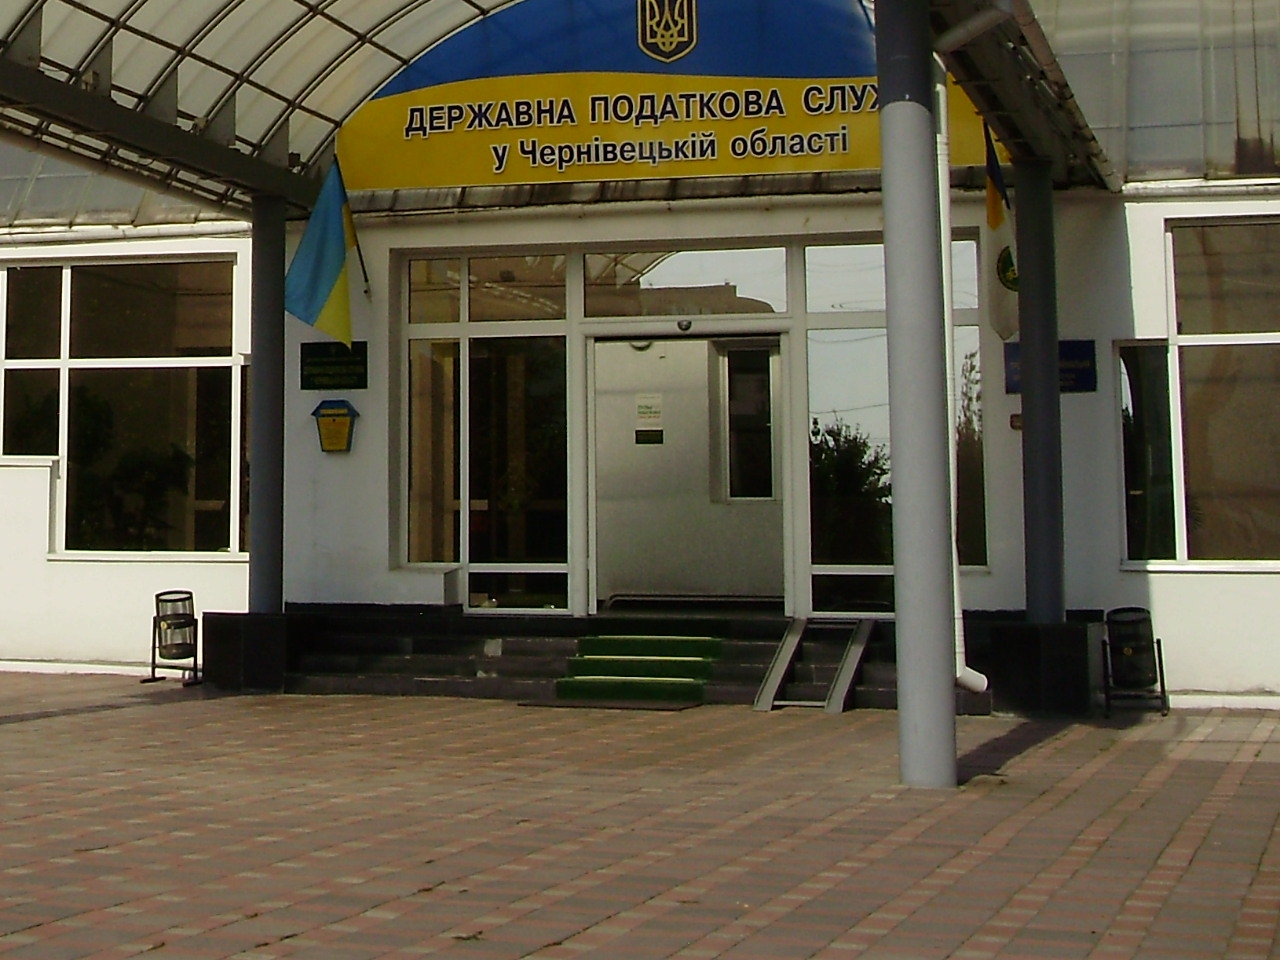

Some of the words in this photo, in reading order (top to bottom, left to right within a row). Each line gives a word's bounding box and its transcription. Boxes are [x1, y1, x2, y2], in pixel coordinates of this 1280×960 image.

[404, 98, 577, 139] ДЕРЖАВНА
[588, 88, 786, 127] ПОДАТКОВА
[490, 143, 510, 173] у
[518, 131, 717, 171] Чернівецькій
[730, 125, 849, 158] області
